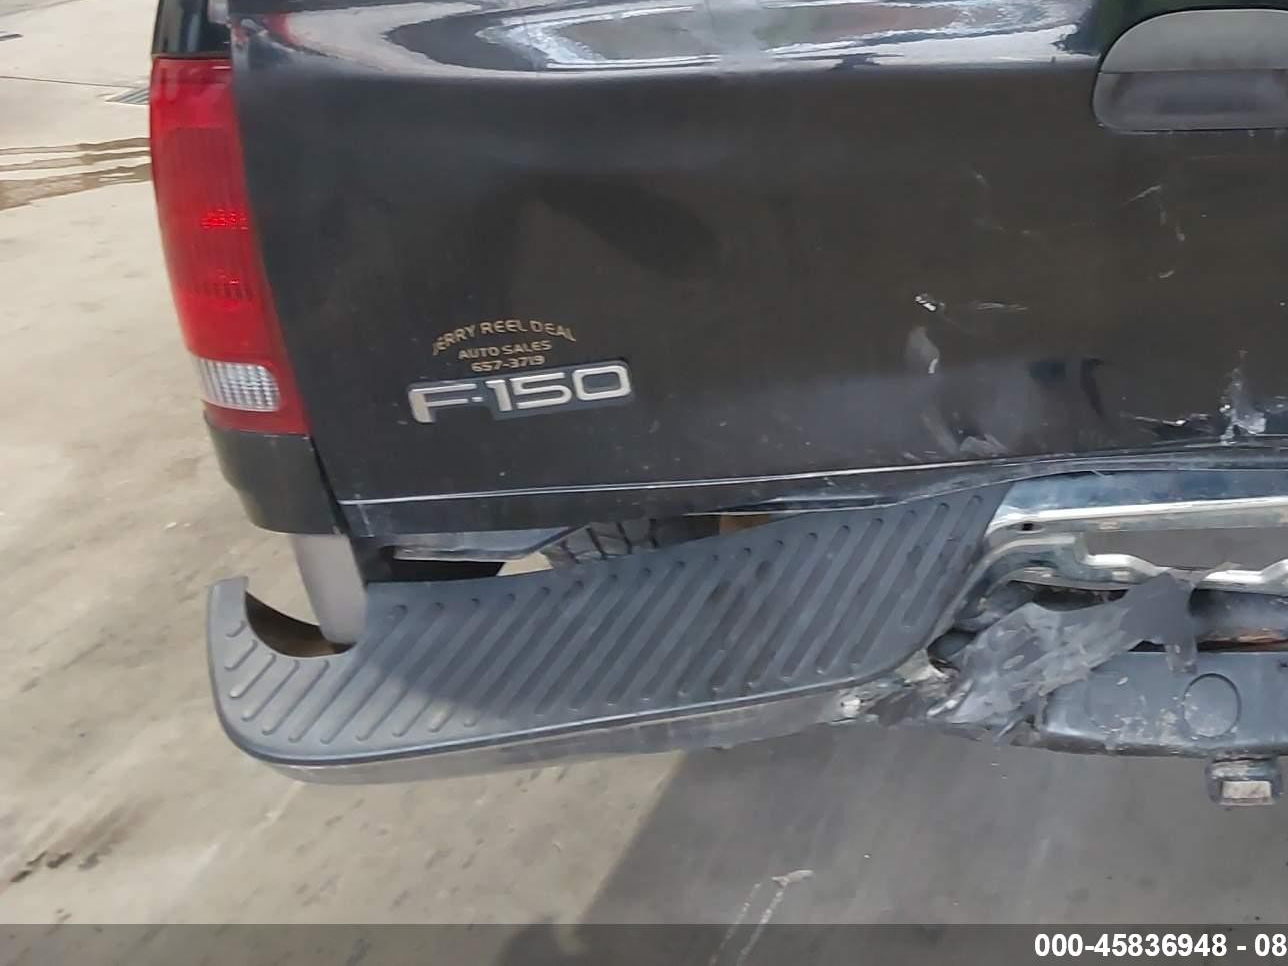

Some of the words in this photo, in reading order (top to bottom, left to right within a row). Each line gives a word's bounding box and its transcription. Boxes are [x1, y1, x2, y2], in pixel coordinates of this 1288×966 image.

[480, 319, 529, 334] REEL
[529, 320, 577, 342] DEAL
[457, 346, 502, 360] AUTO
[502, 340, 553, 355] SALES
[407, 363, 633, 424] F-150
